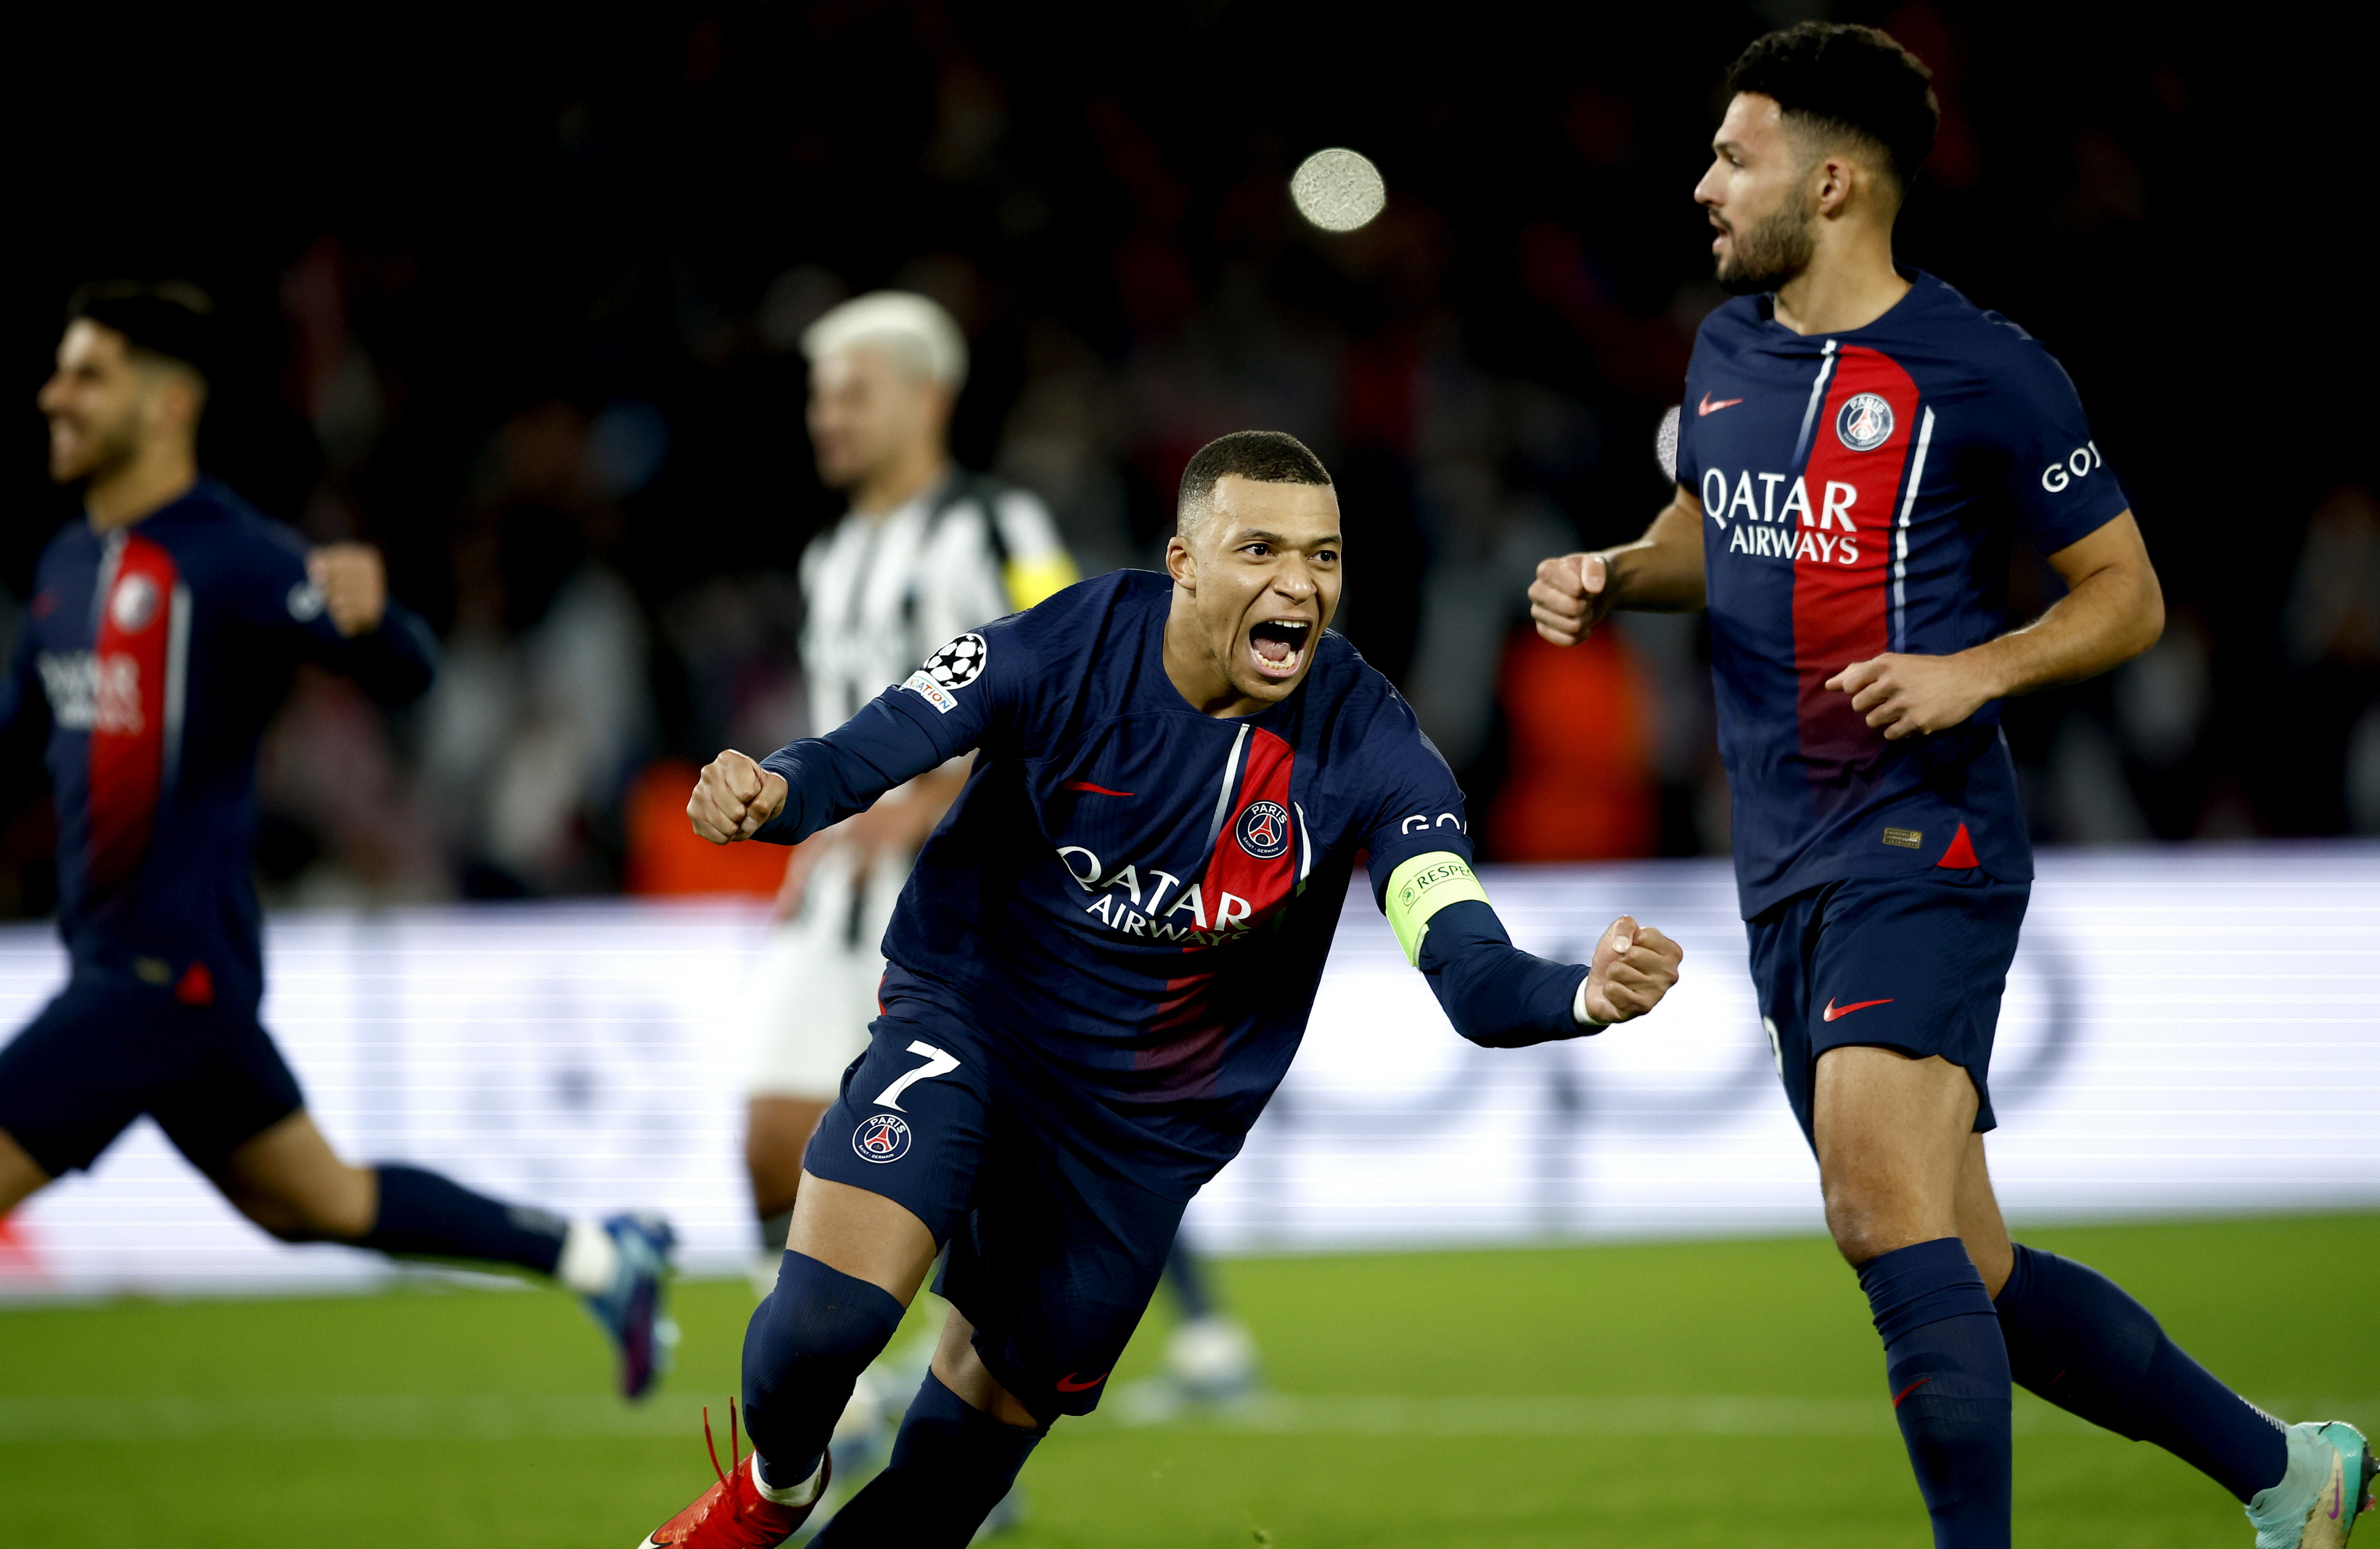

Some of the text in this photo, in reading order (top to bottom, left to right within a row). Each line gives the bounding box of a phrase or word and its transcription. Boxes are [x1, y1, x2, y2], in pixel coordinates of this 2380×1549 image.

[1849, 397, 1886, 414] PARIS
[1703, 467, 1858, 533] QATAR
[1729, 523, 1859, 565] AIRWAYS
[1251, 804, 1287, 824] PARIS
[1401, 812, 1467, 835] GO
[1242, 836, 1255, 850] SAINT
[1055, 845, 1252, 932] QATAR
[872, 1040, 962, 1113] 7
[870, 1116, 906, 1133] PARIS
[858, 1144, 870, 1155] SAINT
